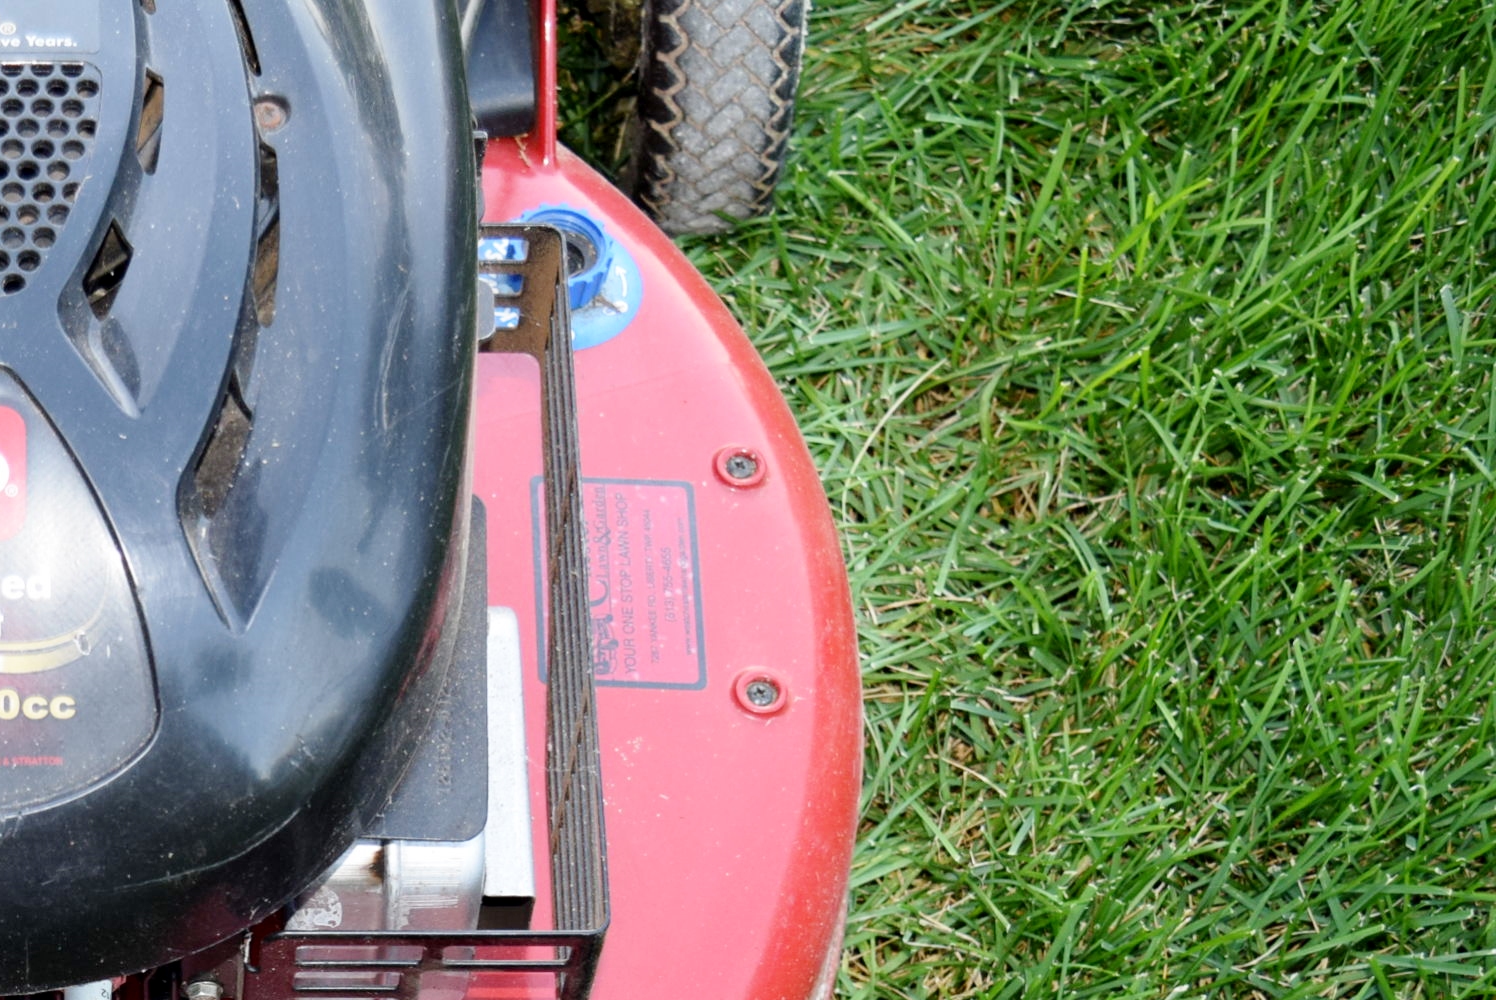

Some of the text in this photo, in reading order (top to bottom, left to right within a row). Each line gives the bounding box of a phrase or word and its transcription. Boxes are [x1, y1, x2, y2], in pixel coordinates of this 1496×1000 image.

[26, 34, 78, 48] Years.
[616, 492, 638, 674] YOUR ONE STOP LAWN SHOP
